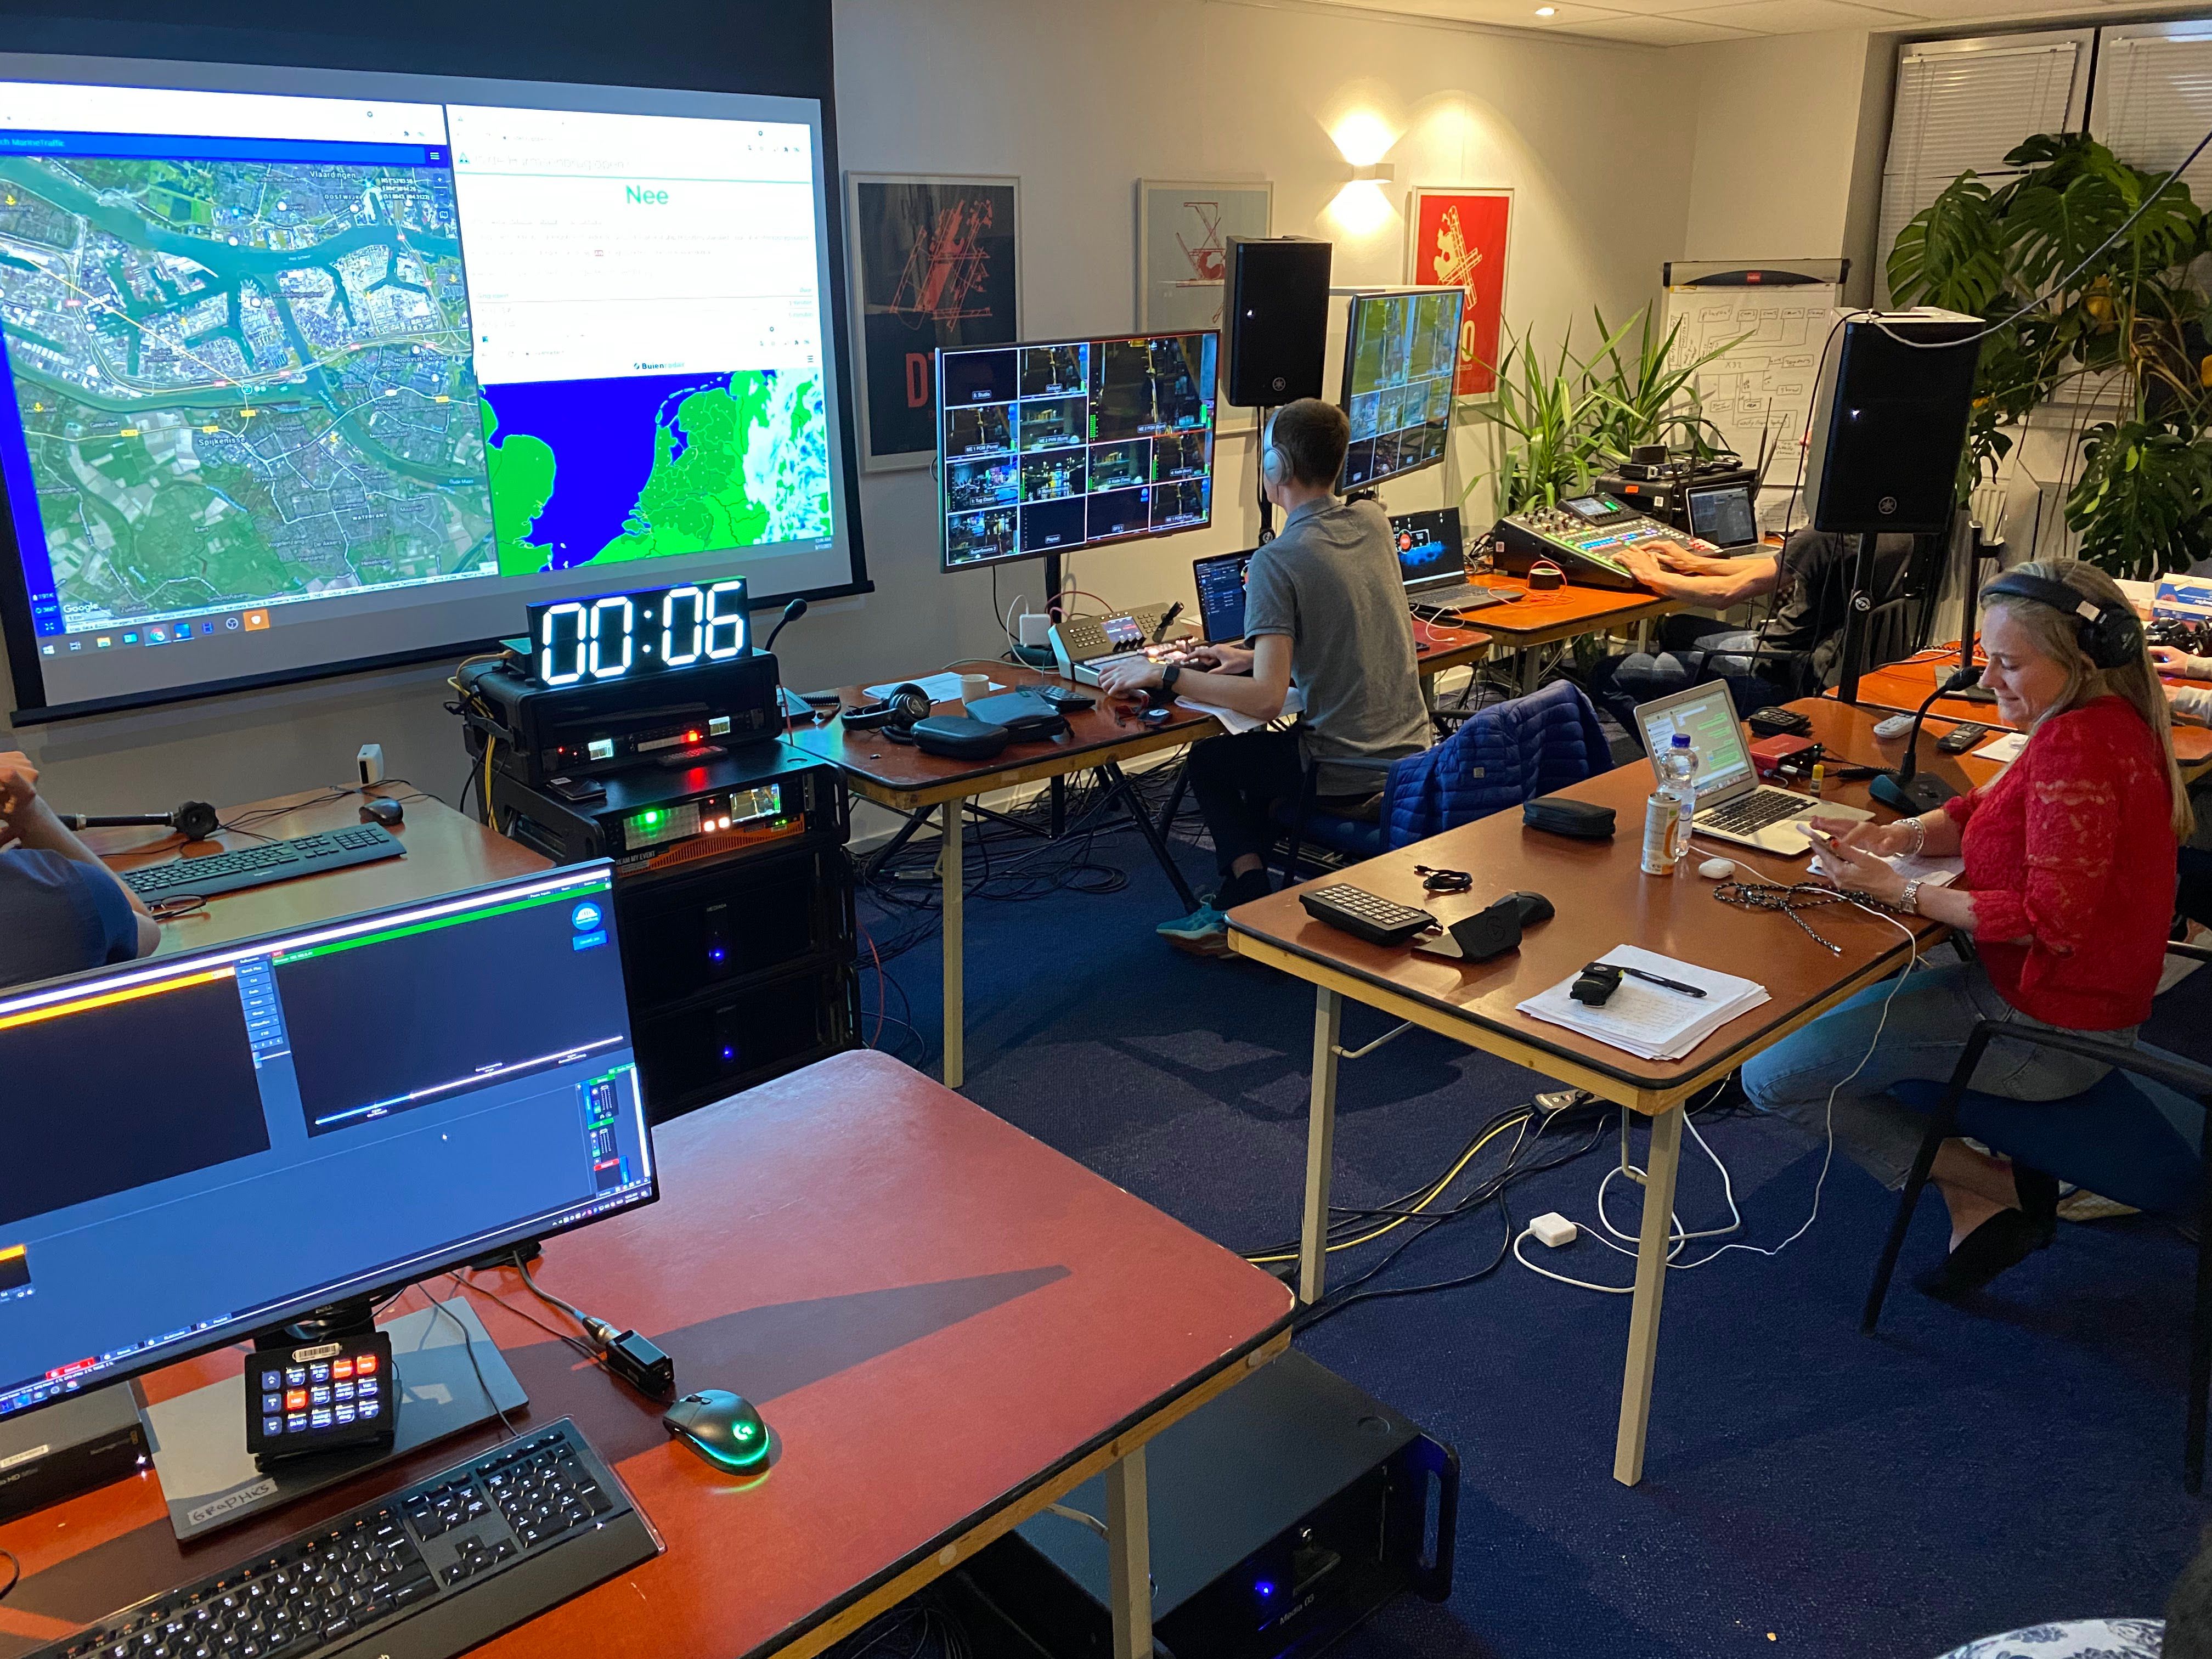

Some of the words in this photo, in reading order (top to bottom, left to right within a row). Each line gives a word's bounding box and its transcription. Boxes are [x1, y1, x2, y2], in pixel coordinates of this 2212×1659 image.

[310, 170, 357, 179] Vlaardingen
[625, 184, 669, 205] Nee
[198, 437, 246, 447] Spijkenisse
[63, 602, 99, 613] Google
[542, 580, 744, 686] 00:06
[639, 850, 655, 860] EVENT
